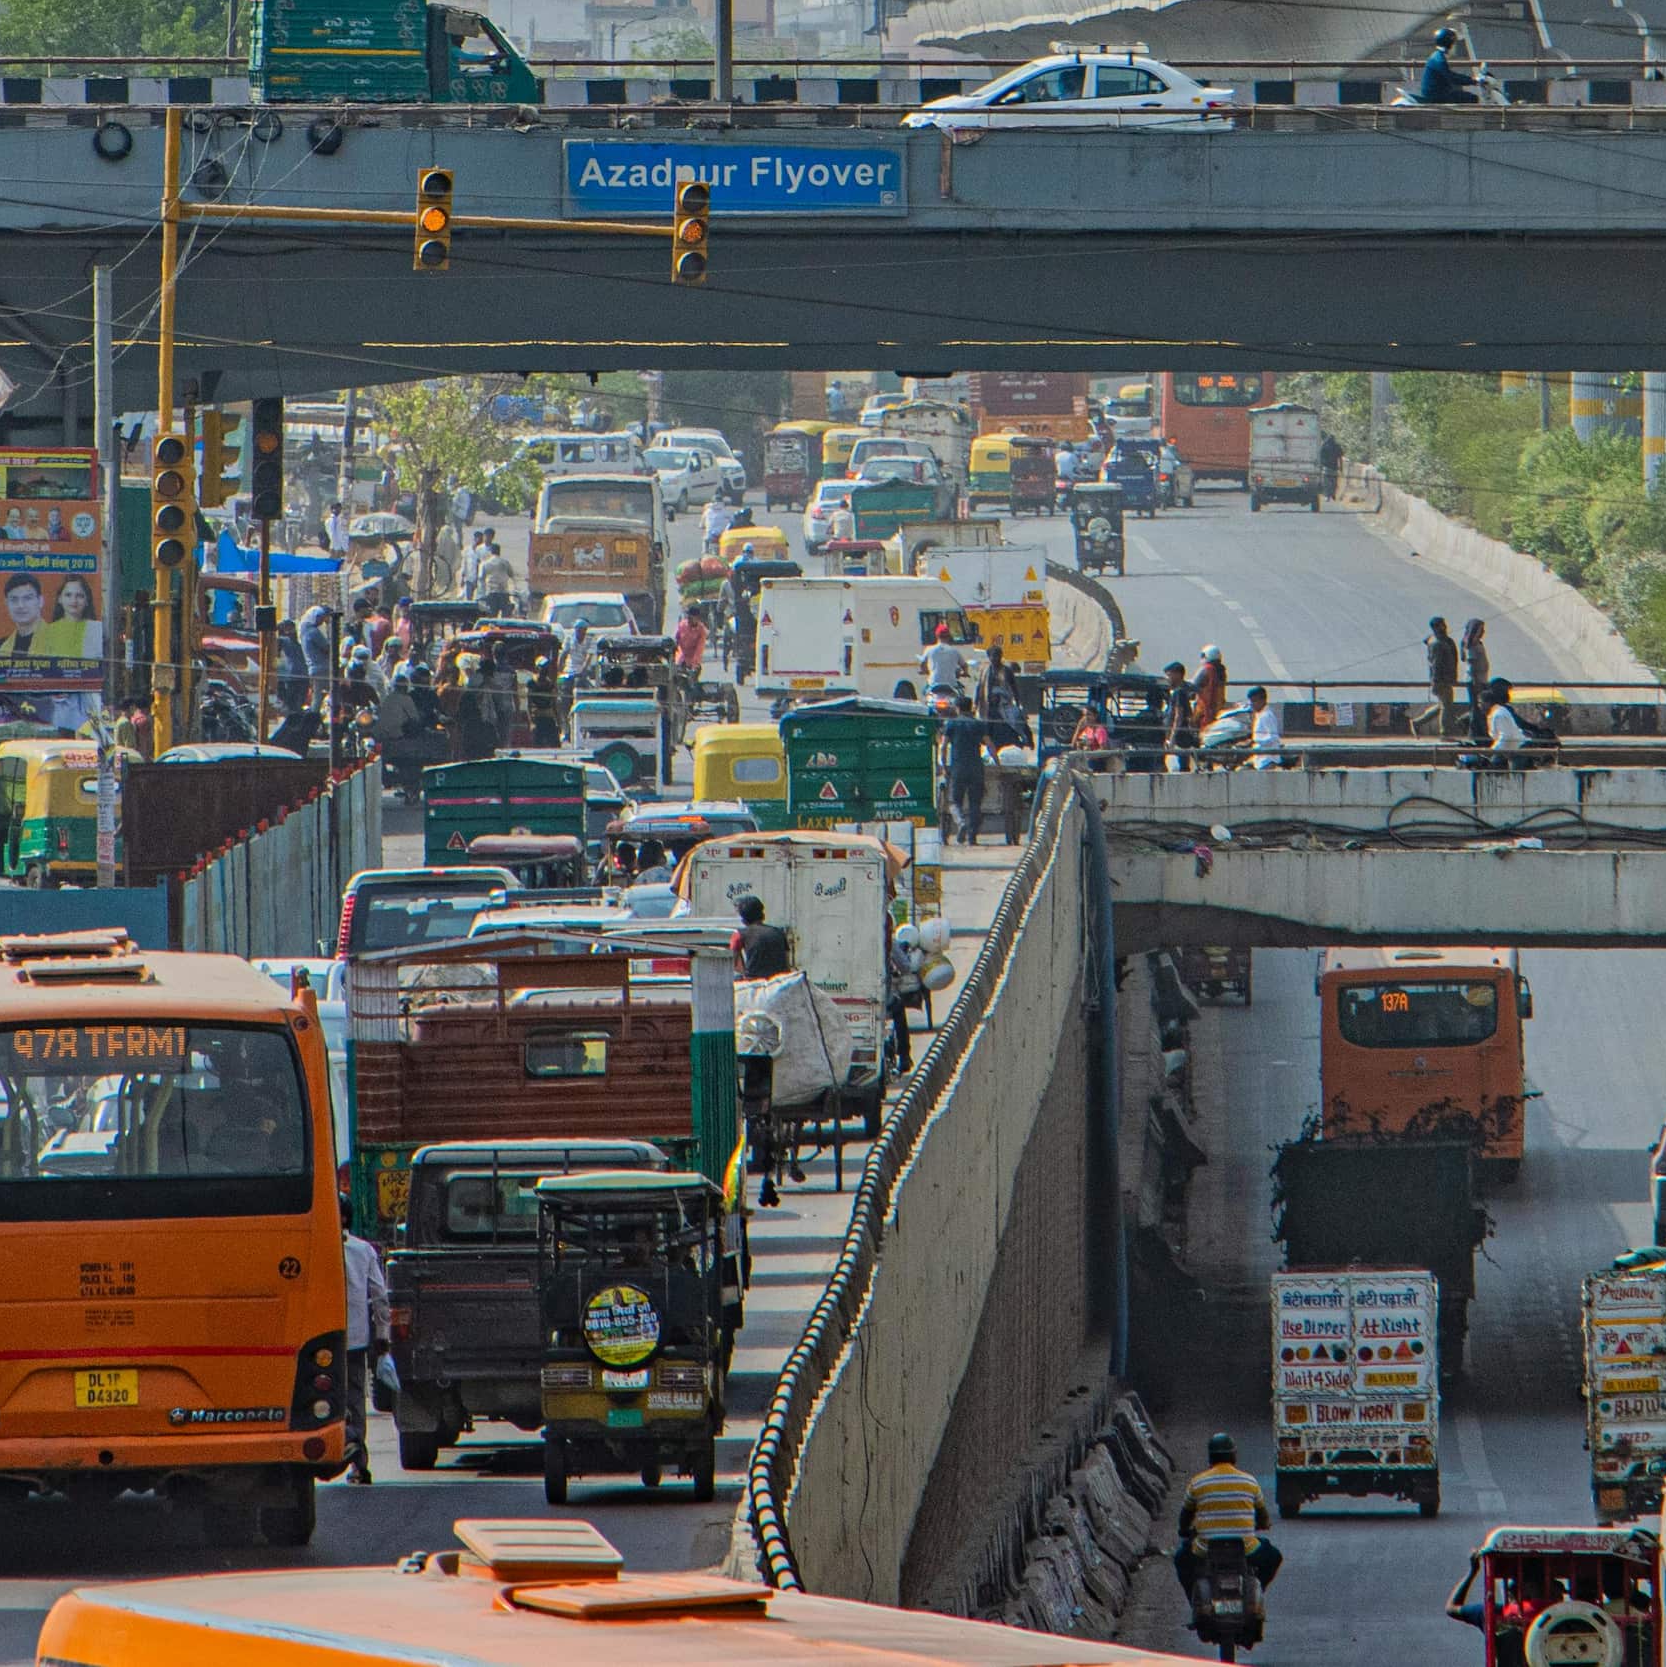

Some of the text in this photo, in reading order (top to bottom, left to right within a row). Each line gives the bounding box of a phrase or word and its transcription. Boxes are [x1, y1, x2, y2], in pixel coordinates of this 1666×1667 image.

[579, 157, 892, 194] Azadpur Flyover
[914, 725, 926, 736] C
[1381, 991, 1408, 1012] 137A
[281, 1261, 299, 1277] 22
[1282, 1317, 1421, 1335] Use Dipper At Night
[89, 1373, 105, 1387] DL
[88, 1389, 129, 1403] D4320
[1316, 1403, 1395, 1423] BLOW HORN
